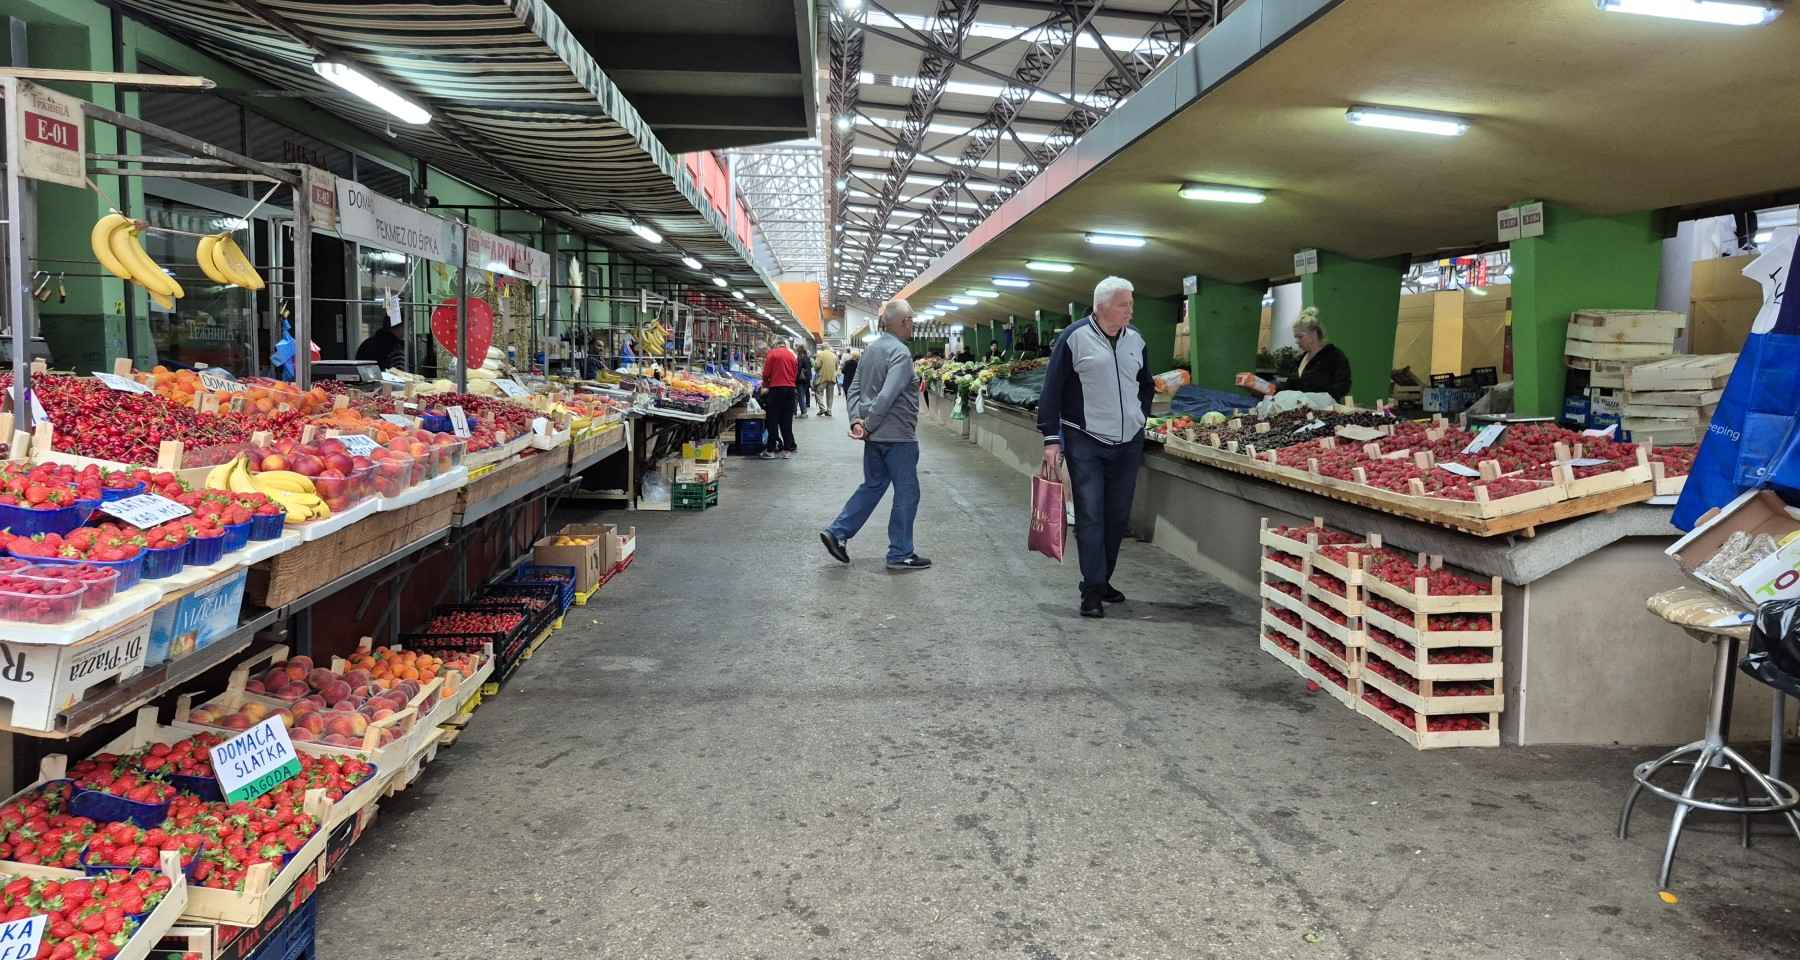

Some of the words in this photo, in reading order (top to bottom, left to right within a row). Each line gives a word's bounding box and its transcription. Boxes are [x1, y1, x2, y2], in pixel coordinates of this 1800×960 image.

[37, 118, 68, 147] E-01
[375, 218, 407, 247] PEKMEZ
[69, 646, 121, 682] Piazza
[123, 636, 142, 661] Di
[216, 723, 277, 765] DOMAĆA
[234, 741, 287, 778] SLATKA
[241, 765, 292, 801] JAGODA
